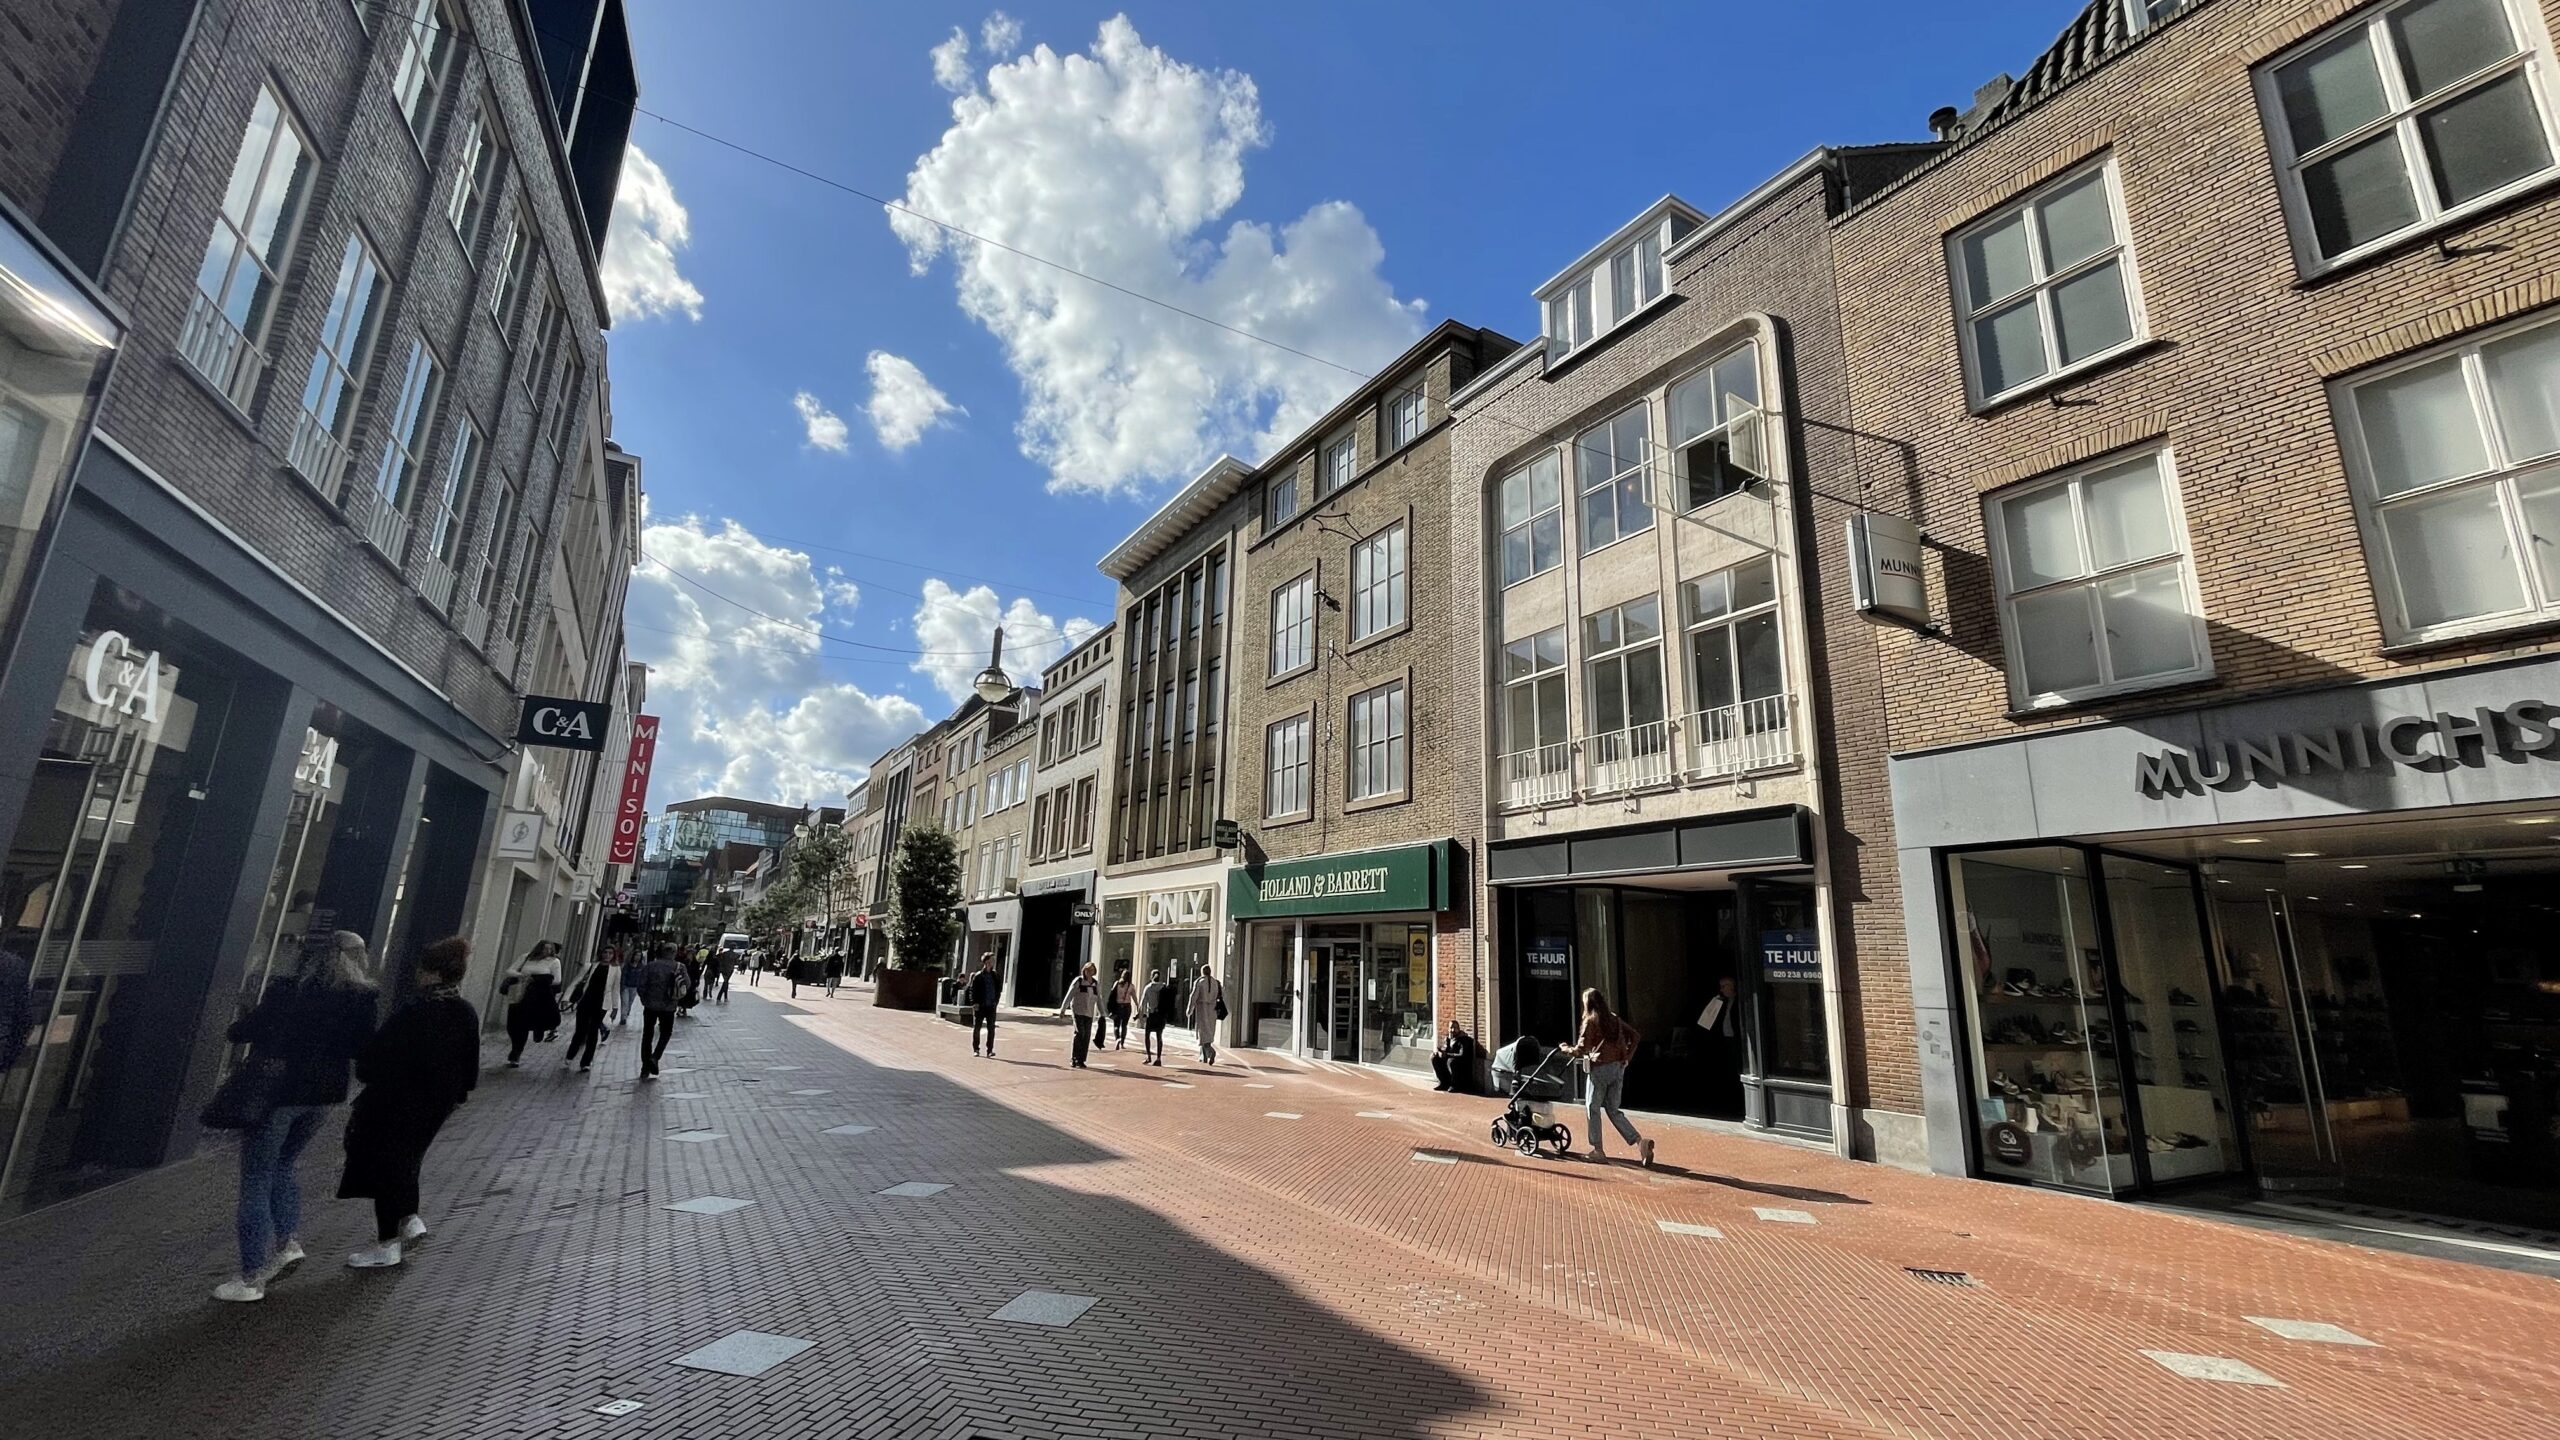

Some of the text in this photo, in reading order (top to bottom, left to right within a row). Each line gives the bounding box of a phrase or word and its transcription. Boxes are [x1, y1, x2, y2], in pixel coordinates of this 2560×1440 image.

[86, 630, 160, 723] C&A
[532, 707, 593, 740] C&A
[2135, 699, 2556, 793] MUNNICHS
[619, 723, 655, 835] MINISO
[1259, 867, 1389, 902] HOLLAND & BARRETT
[1074, 910, 1095, 918] ONLY
[1526, 952, 1566, 964] TE HUUR
[1765, 950, 1784, 964] TE
[1773, 970, 1786, 978] 020
